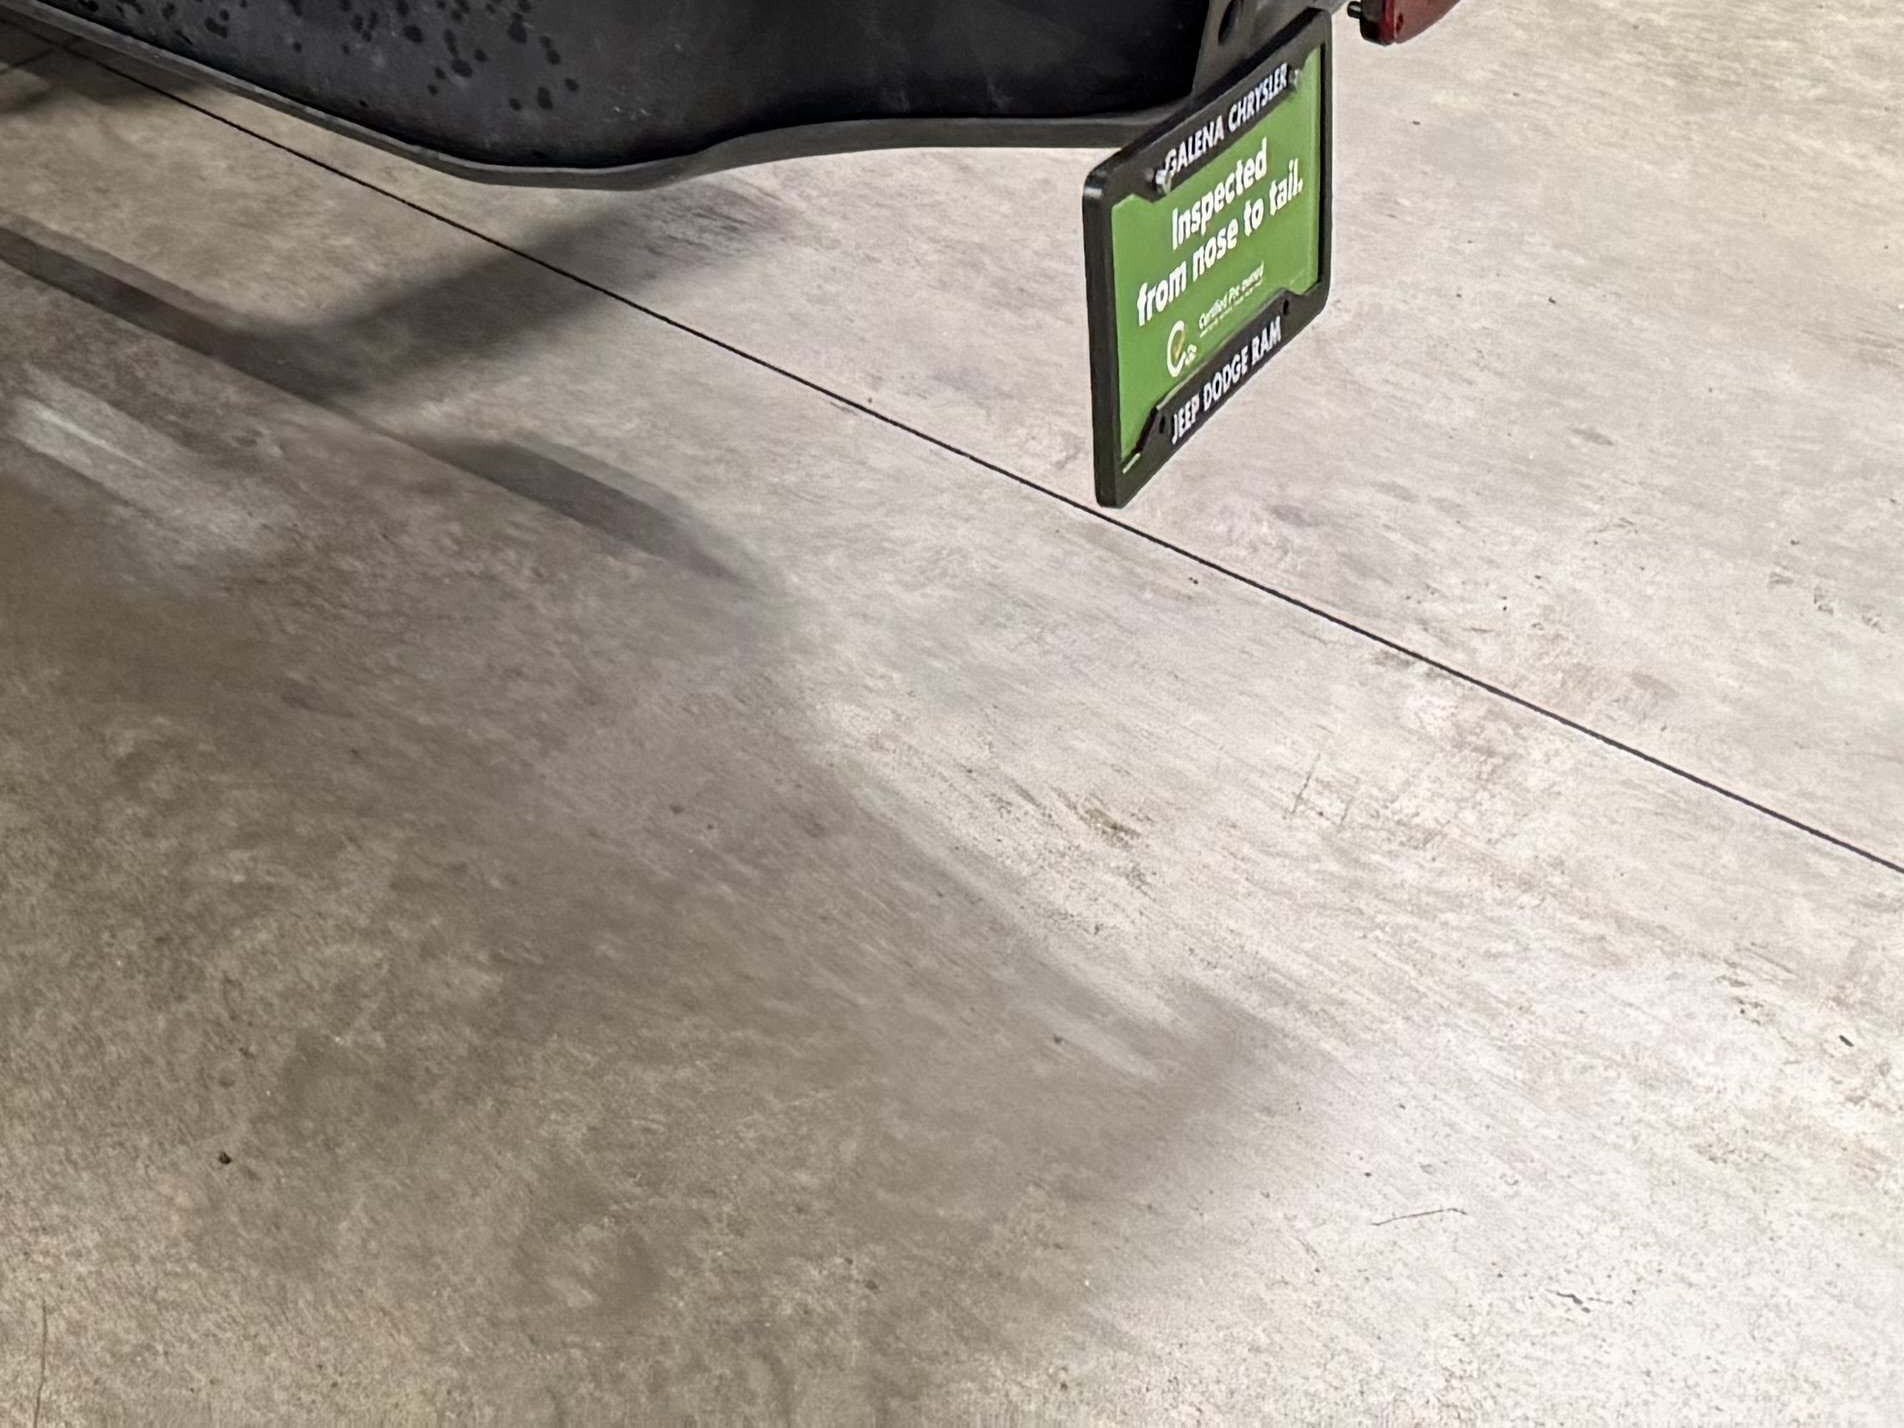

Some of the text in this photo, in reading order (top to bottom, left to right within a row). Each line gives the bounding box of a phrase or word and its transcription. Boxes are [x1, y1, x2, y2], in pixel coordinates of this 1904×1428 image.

[1165, 62, 1288, 175] GALENA CHRYSLER
[1137, 261, 1187, 326] from
[1193, 219, 1238, 282] nose
[1244, 198, 1264, 237] to
[1269, 158, 1304, 216] tail.
[1172, 137, 1267, 250] Inspected
[1172, 394, 1200, 444] JEEP
[1203, 345, 1249, 411] DODGE
[1251, 315, 1282, 366] RAM
